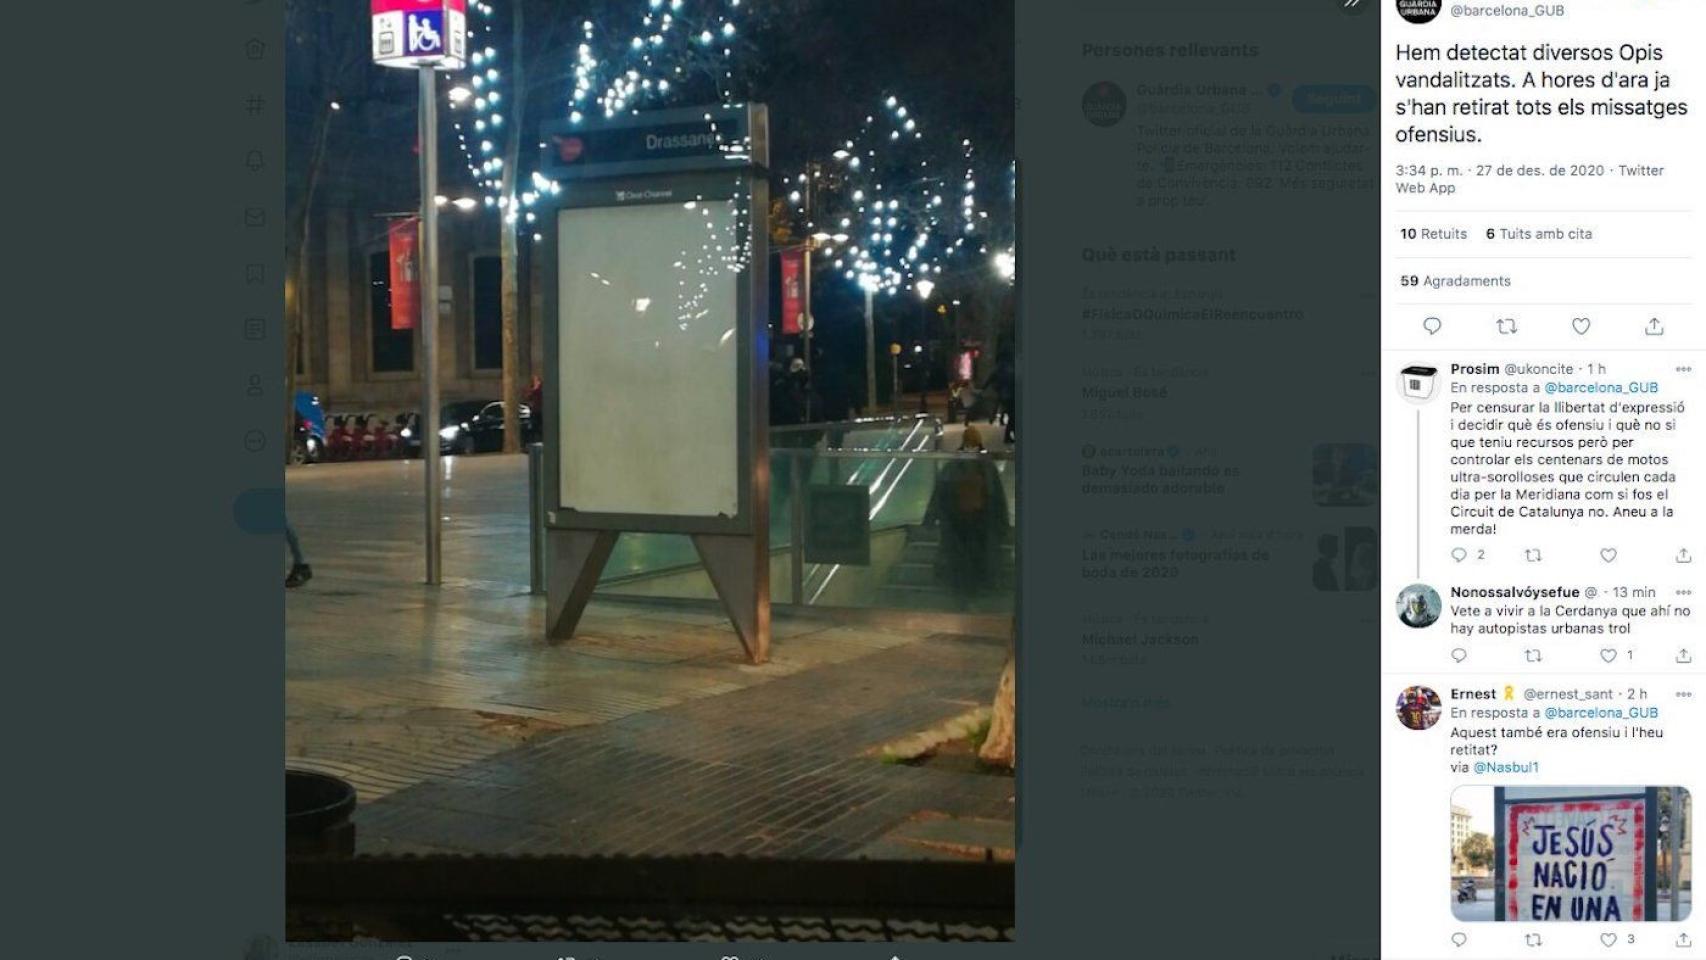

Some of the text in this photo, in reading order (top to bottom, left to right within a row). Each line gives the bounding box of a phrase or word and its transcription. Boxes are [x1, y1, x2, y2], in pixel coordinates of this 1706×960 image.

[1400, 8, 1436, 16] URBANA
[1451, 4, 1564, 18] @barcelona_GUB
[1082, 43, 1259, 57] Persones rellevants
[1396, 43, 1663, 64] Hem detectat diversos Opis
[1395, 70, 1670, 92] vandalitzats. A hores d'ara ja
[1395, 97, 1688, 119] s'han retirat tots els missatges
[1395, 125, 1482, 143] ofensius.
[1396, 164, 1664, 178] 3:34 p. m. 27 de des. de 2020 Twitter
[1396, 182, 1456, 195] Web App
[1400, 228, 1467, 240] 10 Retuits
[1486, 228, 1592, 240] 6 Tuits amb cita
[1082, 247, 1117, 262] Què
[1165, 248, 1236, 266] passant
[1400, 275, 1511, 289] 59 Agradaments
[1451, 362, 1606, 376] Prosim @ukoncite 1 h
[1082, 386, 1129, 401] Miguel
[1451, 382, 1658, 395] En resposta a @barcelona_GUB
[1451, 401, 1685, 415] Per censurar la llibertat d'expressió
[1450, 418, 1676, 433] i decidir què és ofensiu i què no si
[1450, 436, 1634, 450] que teniu recursos però per
[1450, 453, 1669, 465] controlar els centenars de motos
[1082, 464, 1116, 480] Baby
[1120, 464, 1154, 477] Yoda
[1159, 464, 1219, 477] bailando
[1450, 471, 1676, 485] ultra-sorolloses que circulen cada
[1082, 481, 1225, 494] demasiado adorable
[1450, 488, 1668, 502] dia per la Meridiana com si fos el
[1450, 505, 1673, 520] Circuit de Catalunya no. Aneu a la
[1450, 523, 1496, 535] merda!
[1082, 549, 1107, 561] Las
[1111, 549, 1166, 565] mejores
[1252, 549, 1270, 561] de
[1478, 549, 1485, 560] 2
[1082, 566, 1116, 579] boda
[1120, 566, 1138, 579] de
[1450, 585, 1580, 601] Nonossalvóysefue
[1613, 586, 1628, 598] 13
[1632, 586, 1656, 598] min
[1450, 604, 1691, 619] Vete a vivir a la Cerdanya que ahí no
[1451, 622, 1630, 636] hay autopistas urbanas trol
[1082, 633, 1199, 646] Michael Jackson
[1627, 650, 1633, 660] 1
[1451, 688, 1496, 700] Ernest
[1524, 688, 1647, 701] @ernest_sant 2 h
[1451, 707, 1658, 720] En resposta a @barcelona_GUB
[1450, 725, 1663, 740] Aquest també era ofensiu i l'heu
[1450, 744, 1498, 756] retitat?
[1450, 761, 1469, 773] via
[1532, 895, 1622, 921] EN UNA
[1628, 934, 1635, 944] 3
